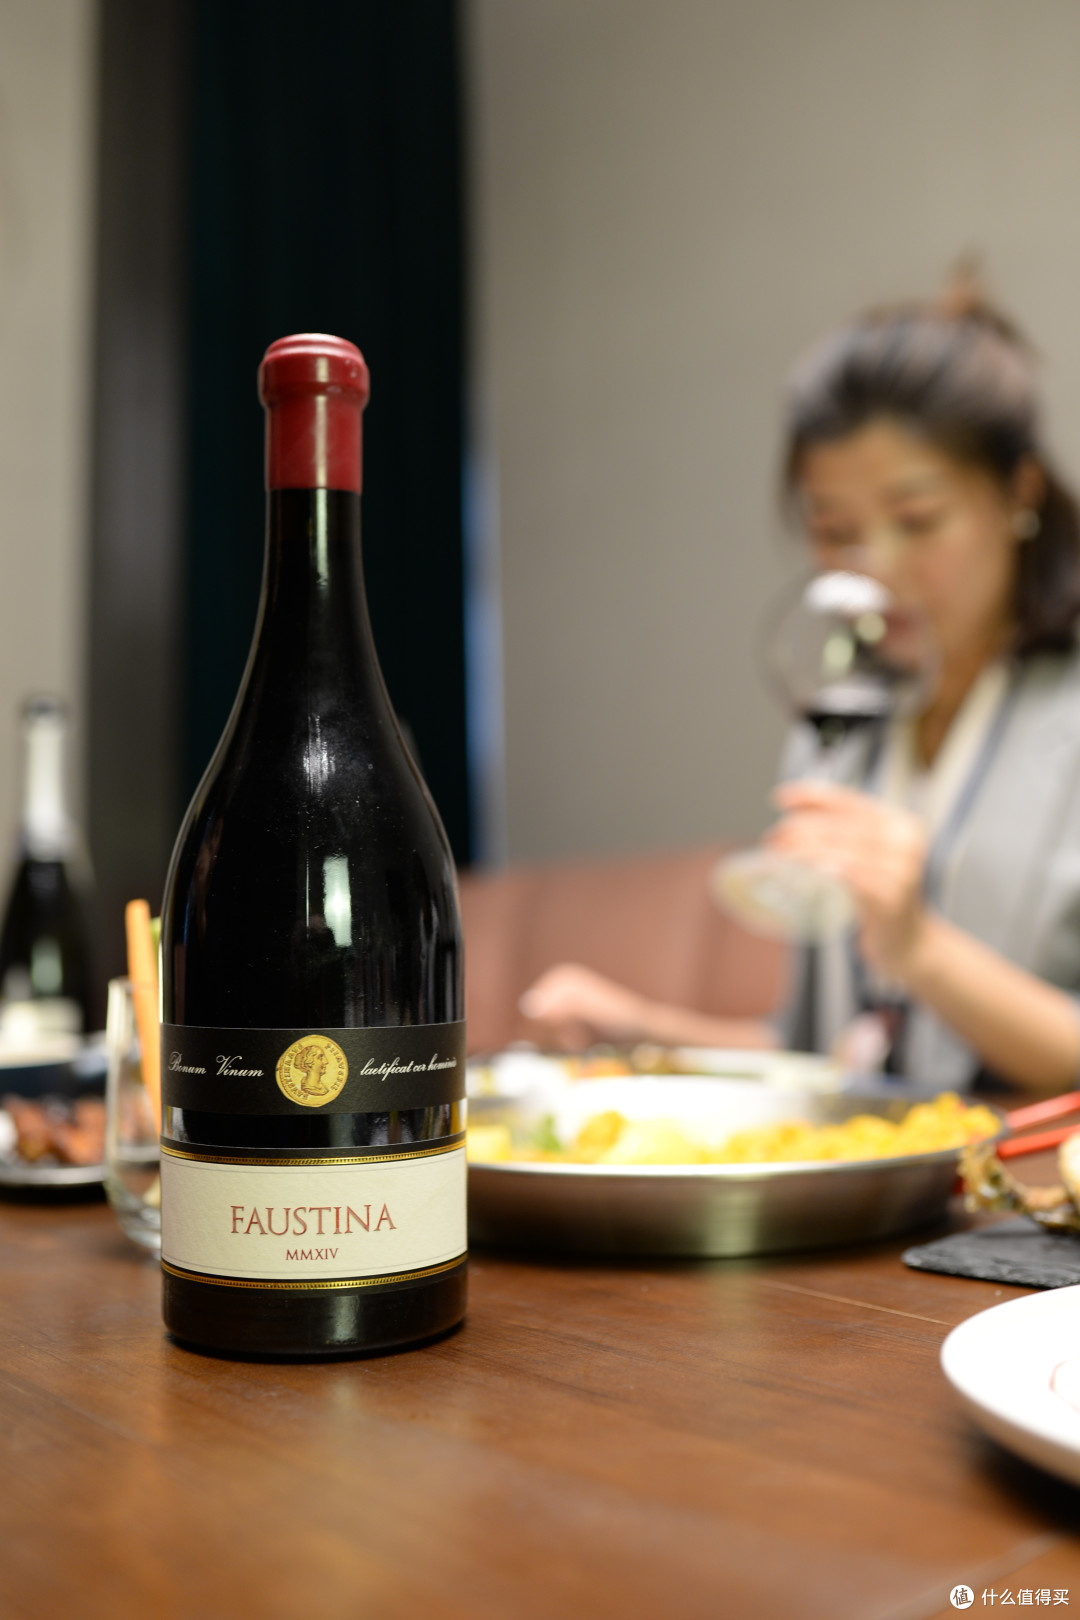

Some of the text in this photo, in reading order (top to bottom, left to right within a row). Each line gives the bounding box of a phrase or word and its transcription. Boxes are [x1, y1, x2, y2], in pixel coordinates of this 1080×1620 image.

[167, 1051, 207, 1075] Bonum
[215, 1054, 265, 1077] Vinum
[360, 1057, 415, 1082] laetificat
[412, 1063, 427, 1073] cor
[230, 1203, 397, 1236] FAUSTINA
[285, 1247, 339, 1261] MMXIV
